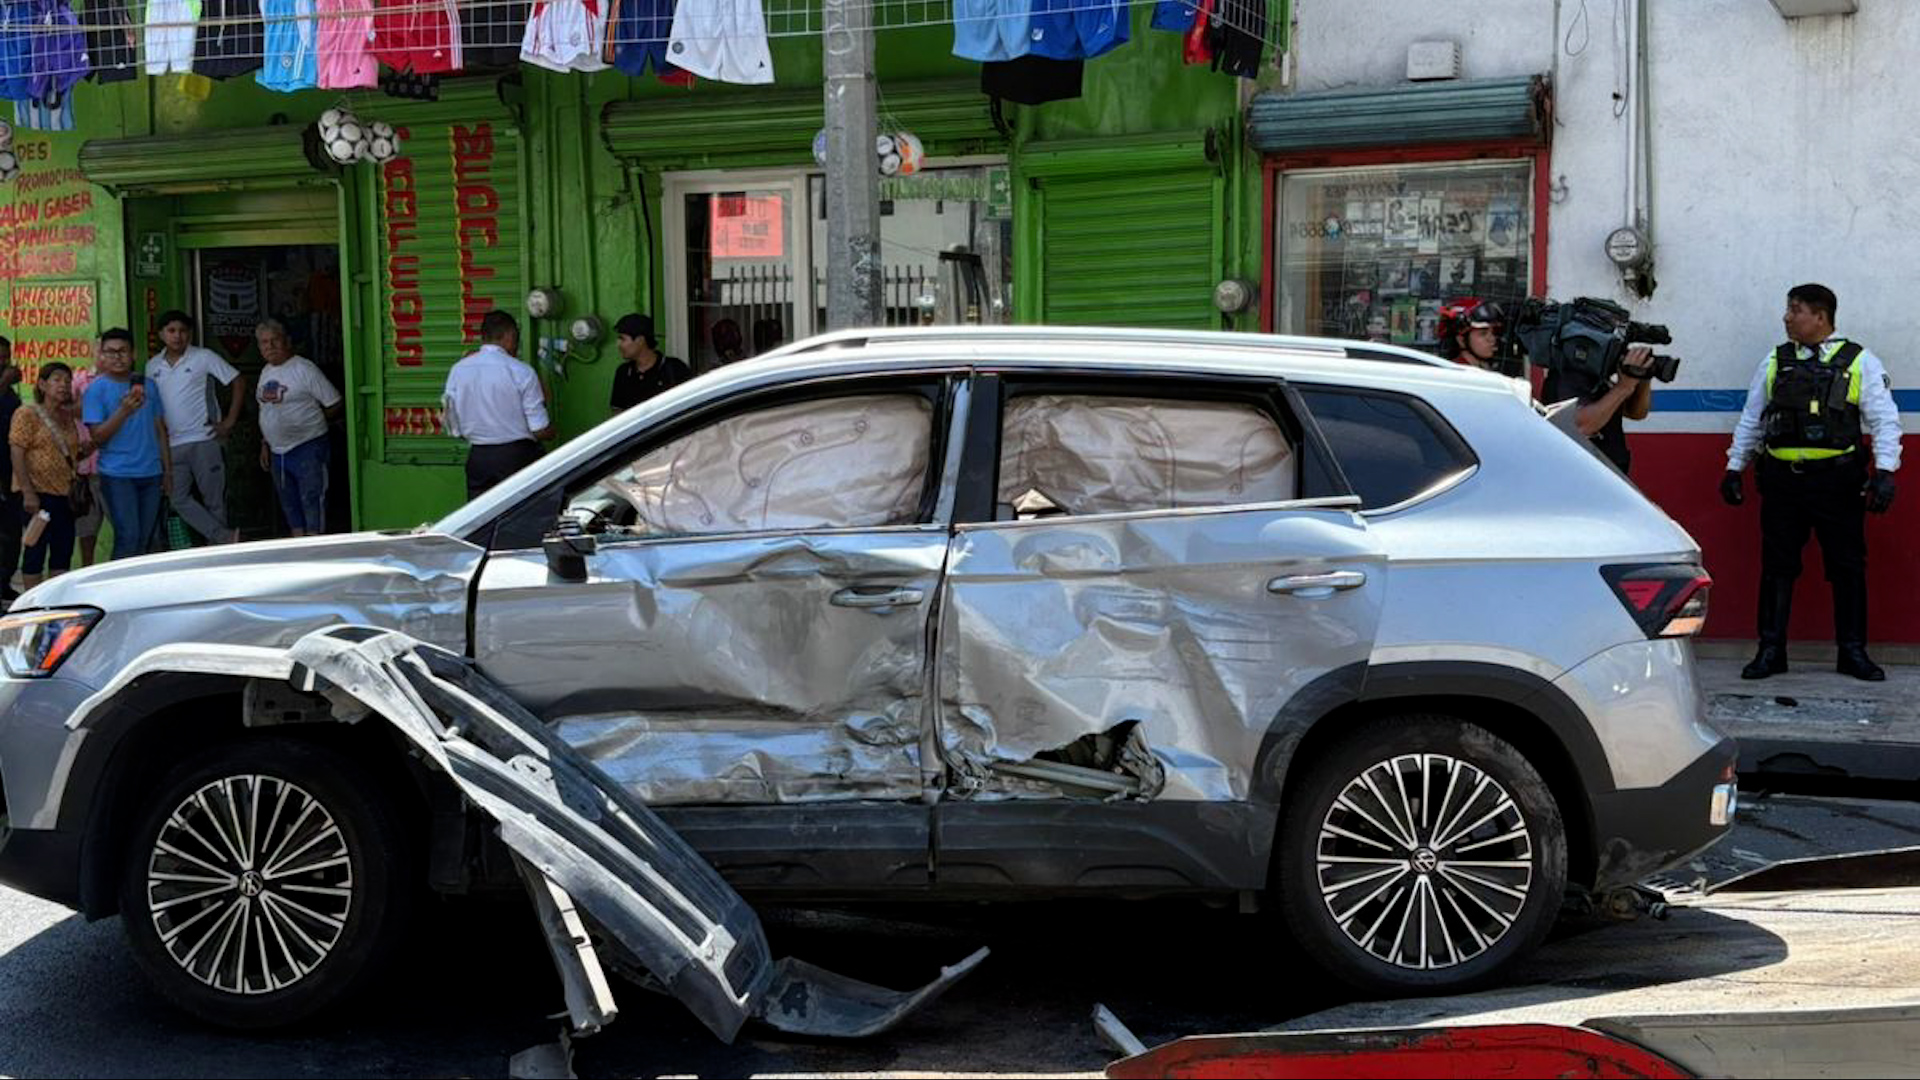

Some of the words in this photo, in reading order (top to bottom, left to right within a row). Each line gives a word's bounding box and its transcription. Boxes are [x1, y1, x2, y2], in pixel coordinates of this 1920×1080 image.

[12, 284, 94, 308] UNIFORMES
[381, 127, 425, 367] ROFEOS
[451, 120, 500, 354] MEDALLA
